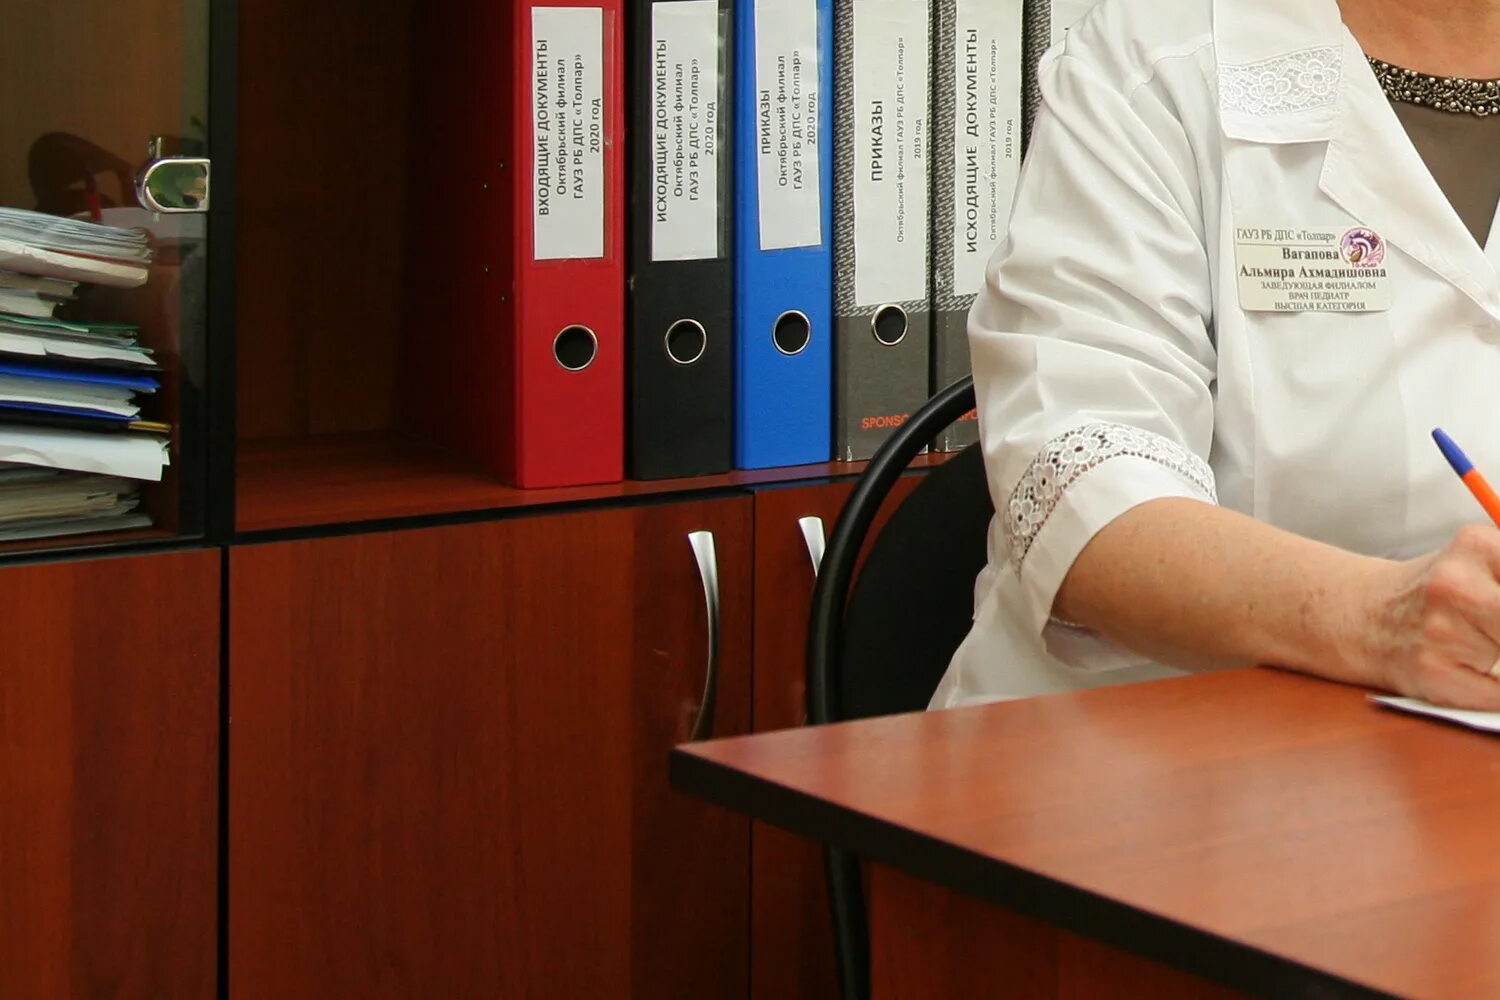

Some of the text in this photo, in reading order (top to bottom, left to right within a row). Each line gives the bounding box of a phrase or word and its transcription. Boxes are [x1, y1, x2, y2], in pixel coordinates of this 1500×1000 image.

[896, 37, 906, 82] «Толпар»
[536, 39, 550, 216] ВХОДЯЩИЕ ДОКУМЕНТЫ
[556, 58, 567, 195] Октябрьский филиал
[574, 54, 584, 198] ГАУЗ РБ ДПС «Толпар»
[590, 98, 602, 153] 2020 год
[656, 39, 669, 221] ИСХОДЯЩИЕ ДОКУМЕНТЫ
[674, 63, 684, 197] Октябрьский филиал
[690, 58, 700, 201] ГАУЗ РБ ДПС «Толпар»
[705, 101, 716, 155] 2020 год
[761, 90, 771, 154] ПРИКАЗЫ
[778, 56, 788, 186] Октябрьский филиал
[793, 50, 803, 190] ГАУЗ РБ ДПС «Толпар»
[807, 92, 817, 145] 2020 год
[897, 106, 904, 117] РБ
[871, 101, 883, 181] ПРИКАЗЫ
[897, 144, 905, 179] филиал
[967, 29, 980, 252] ИСХОДЯЩИЕ ДОКУМЕНТЫ
[896, 182, 904, 242] Октябрьский
[1237, 229, 1336, 243] ГАУЗ РБ ДПС «Толпар»
[1240, 266, 1295, 280] Альмира
[1283, 248, 1339, 260] Вагапова
[1261, 281, 1323, 290] ЗАВЕДУЮЩАЯ
[1275, 302, 1365, 310] ВЫСШАЯ КАТЕГОРИЯ
[1289, 292, 1349, 301] ВРАЧ ПЕДИАТР
